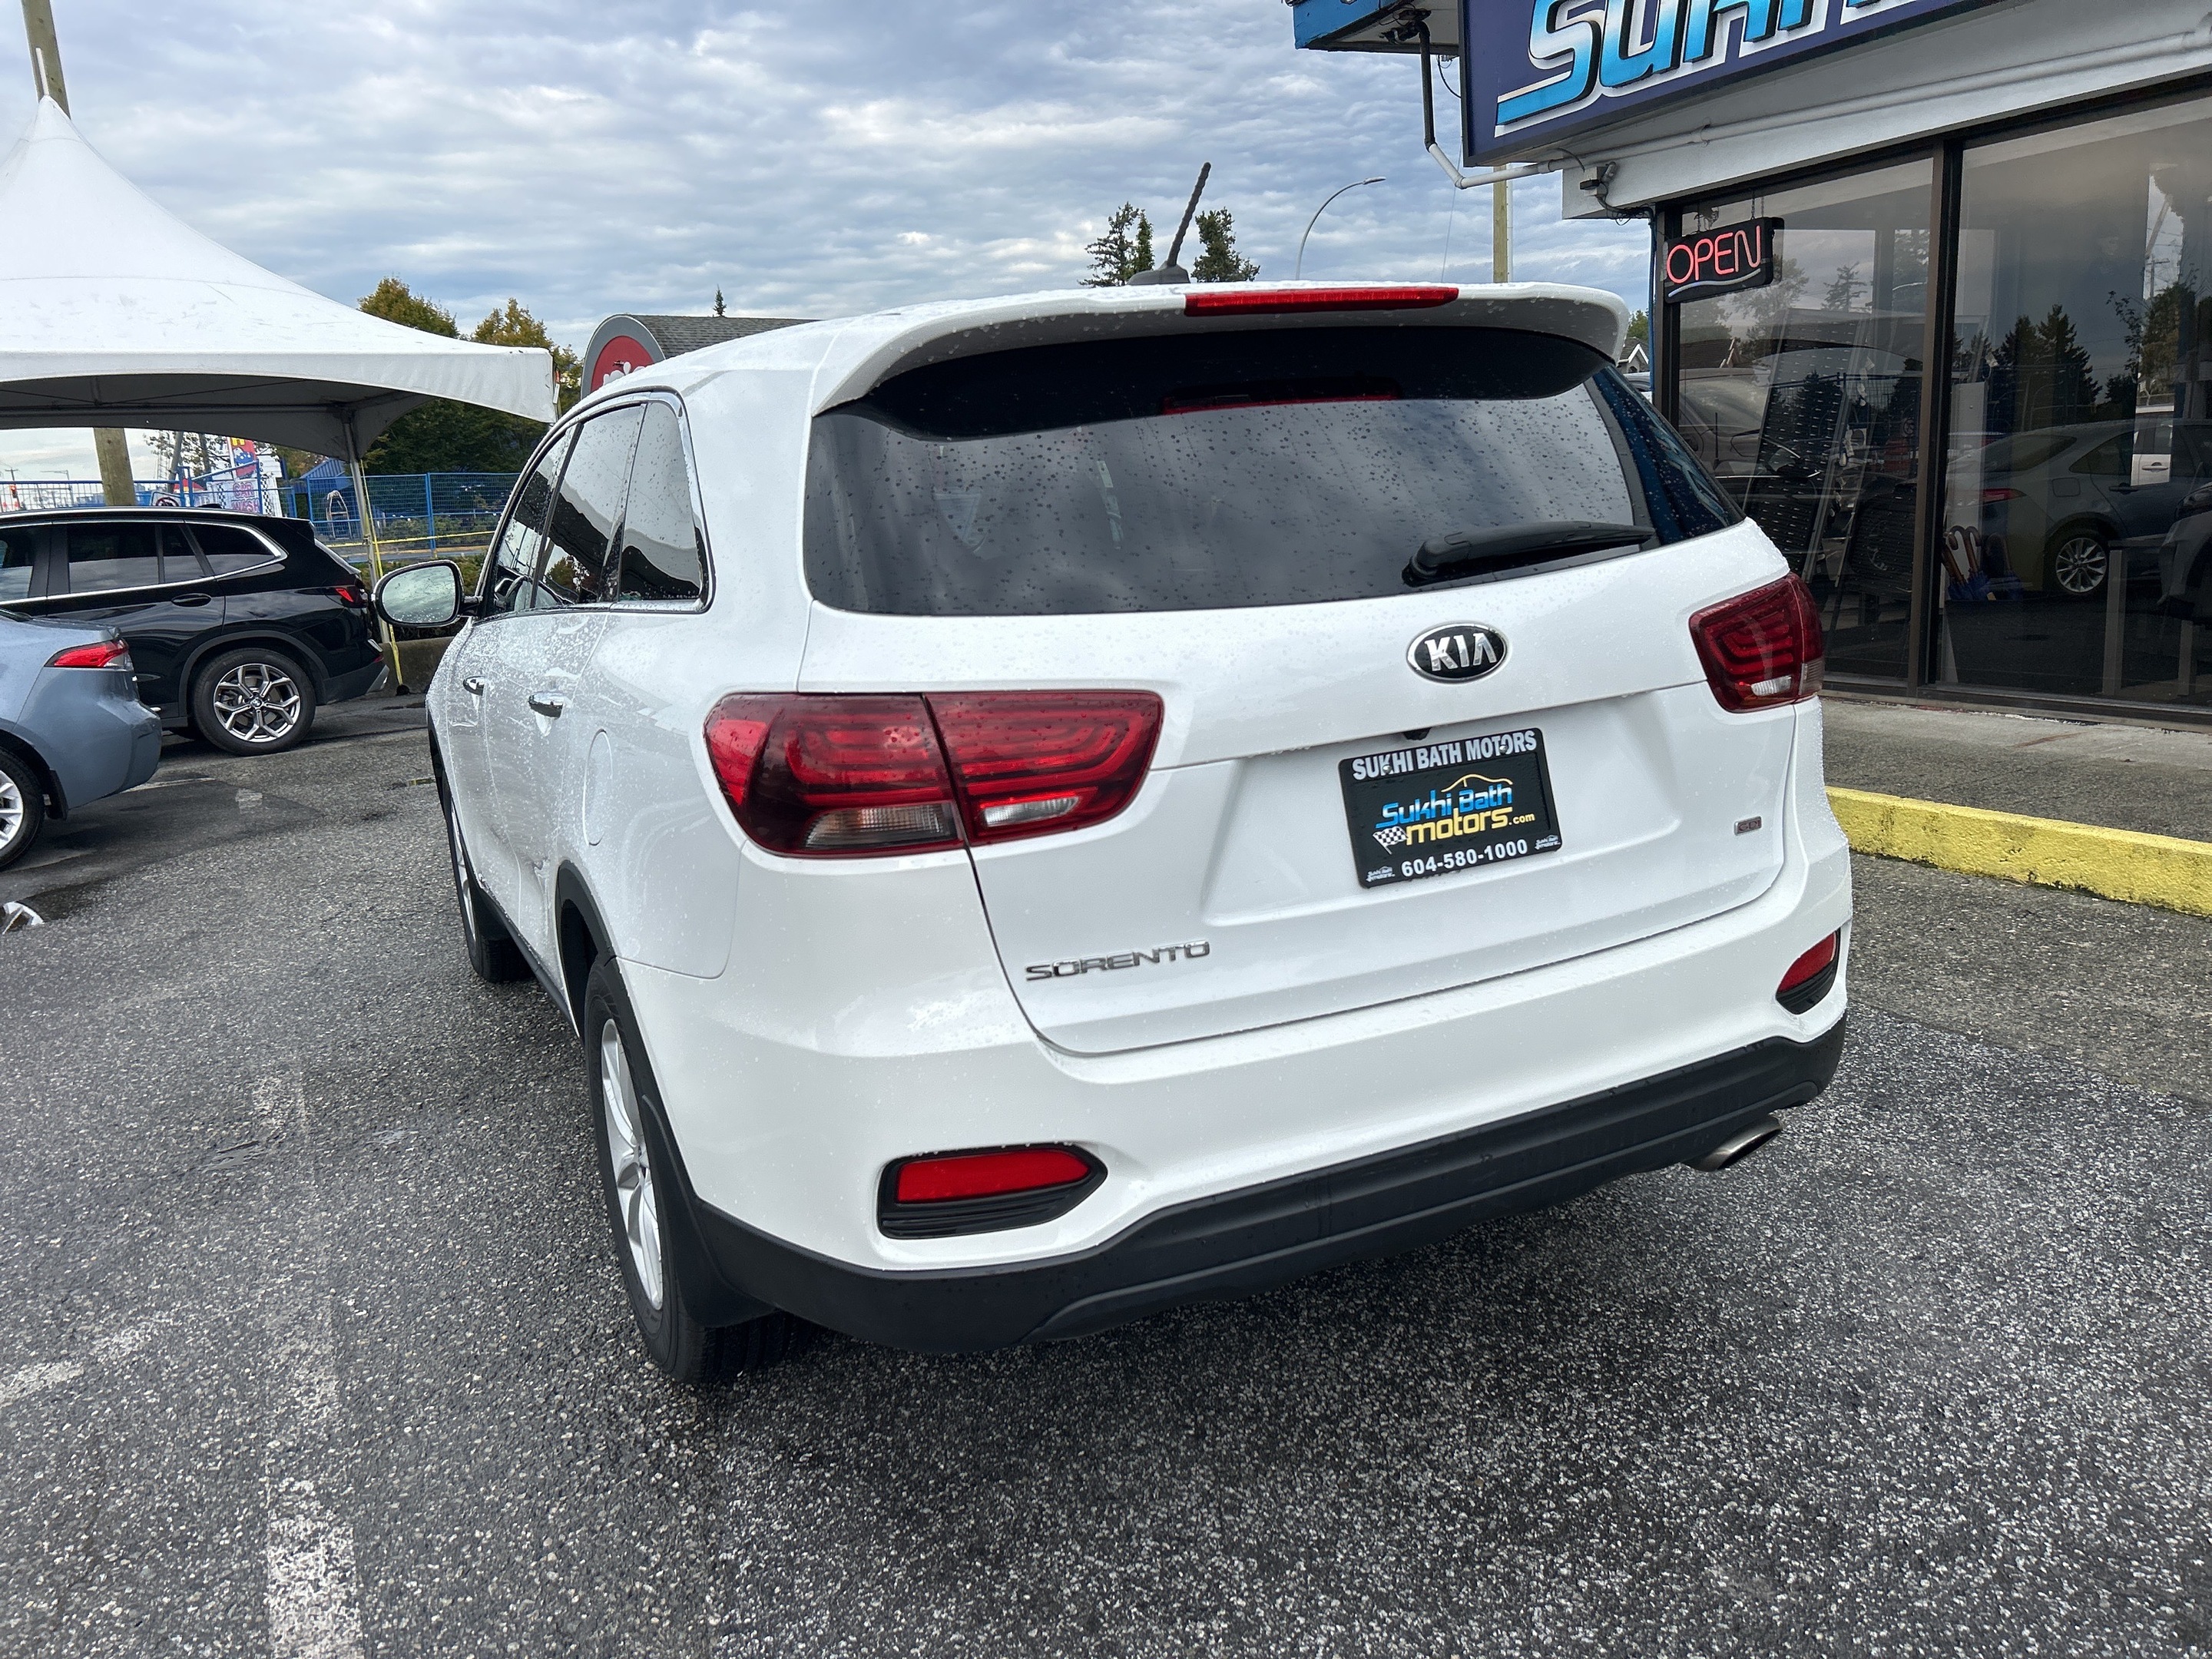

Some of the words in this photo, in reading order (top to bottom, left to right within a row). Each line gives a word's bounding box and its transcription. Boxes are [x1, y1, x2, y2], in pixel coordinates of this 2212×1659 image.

[1667, 225, 1761, 283] OPEN
[233, 482, 255, 498] CAR
[1425, 632, 1497, 671] KIA
[1352, 750, 1414, 780] SUKHI
[1416, 743, 1462, 769] BATH
[1465, 730, 1537, 761] MOTORS
[1376, 790, 1452, 829] Sukhi
[1459, 783, 1512, 813] Bath
[1401, 839, 1528, 877] 604-580-1000
[1025, 939, 1210, 981] SORENTO
